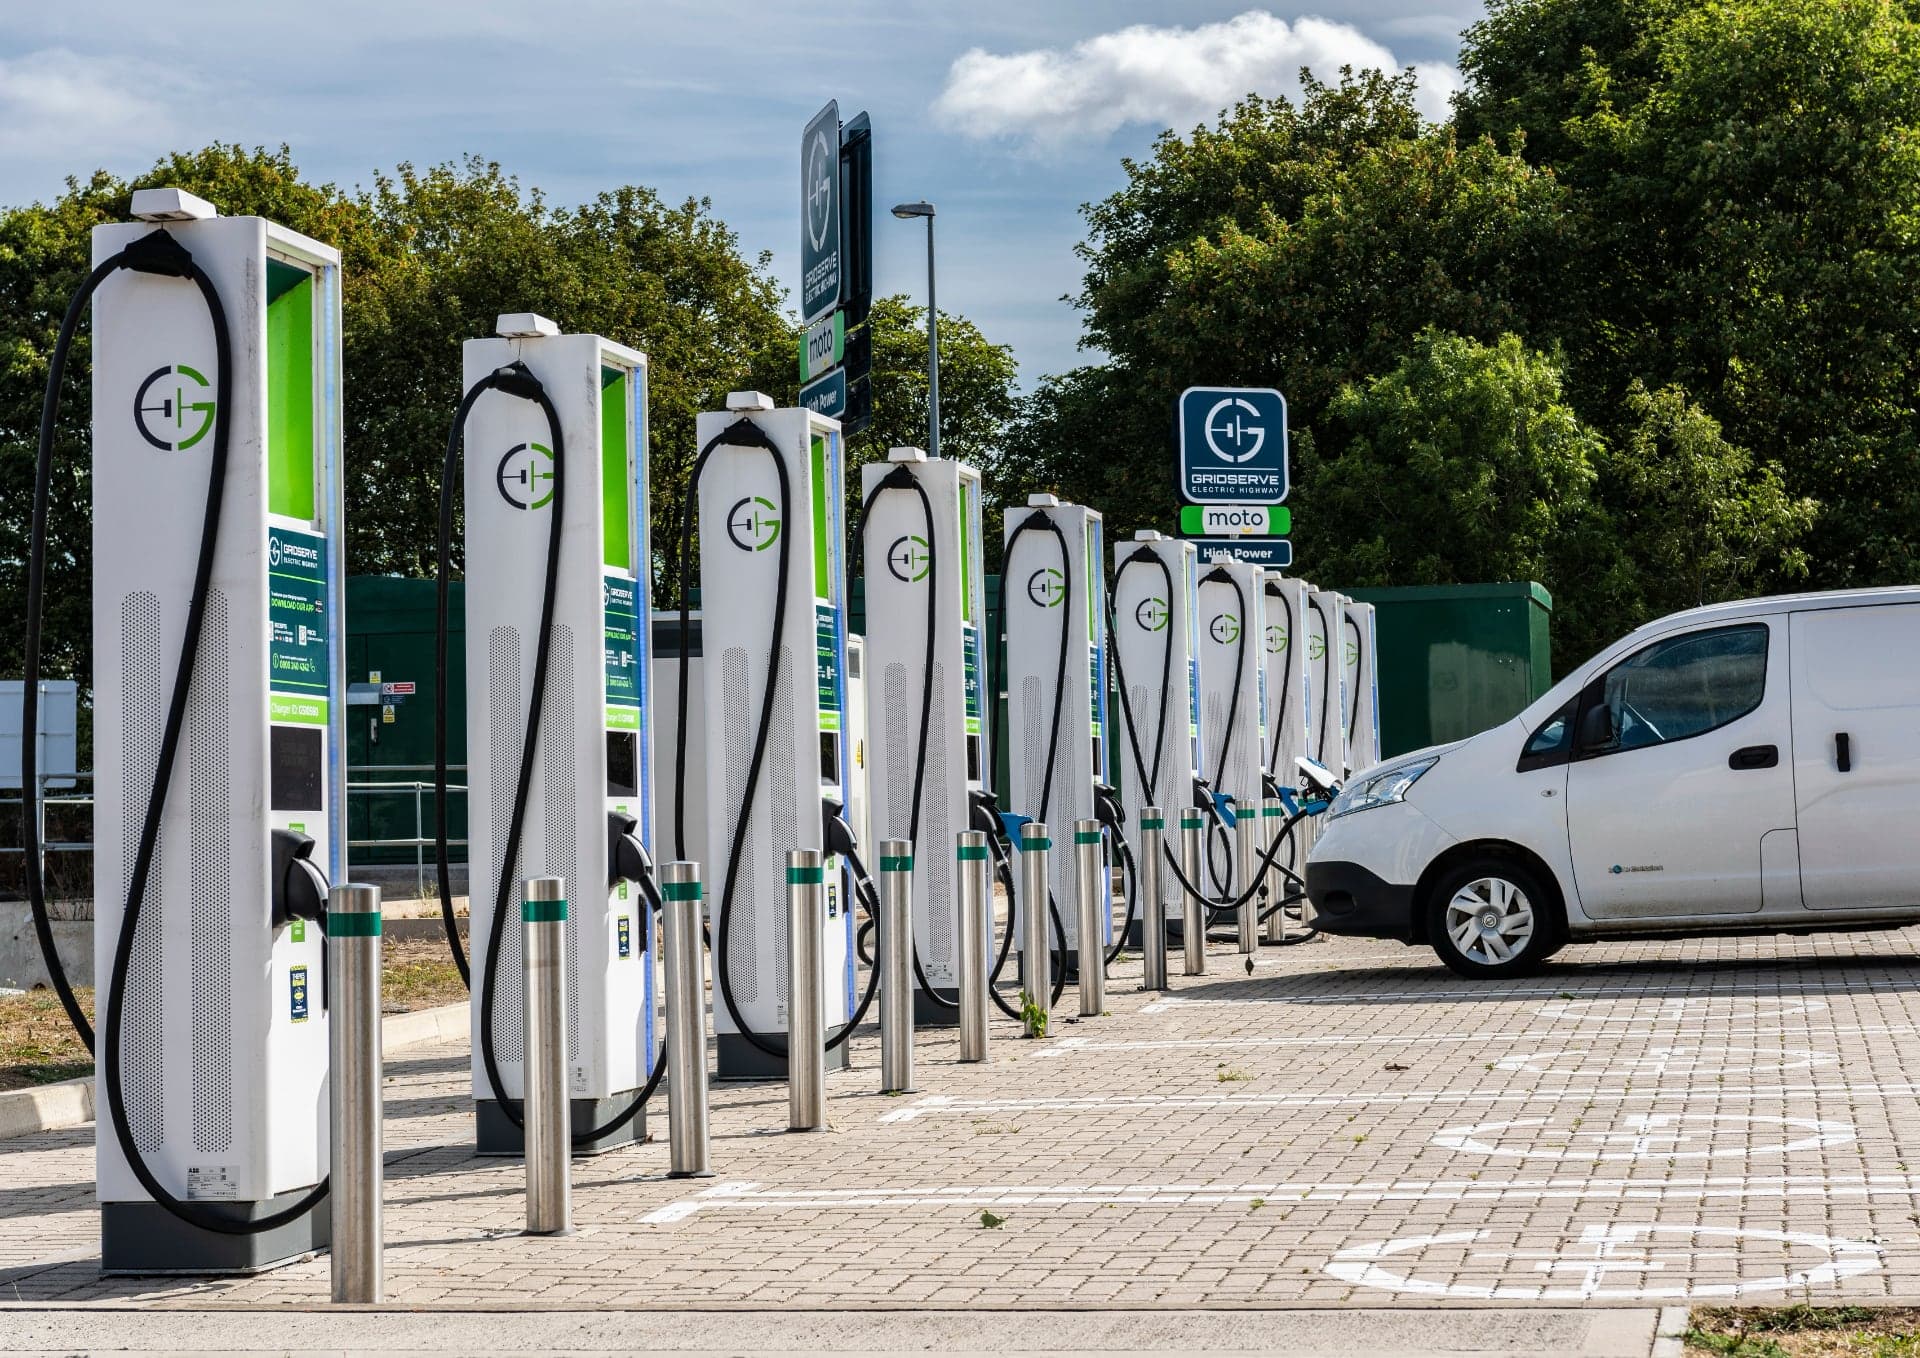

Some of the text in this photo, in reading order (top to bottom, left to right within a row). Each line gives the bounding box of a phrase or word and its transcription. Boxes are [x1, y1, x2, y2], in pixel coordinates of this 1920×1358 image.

[809, 326, 833, 362] moto
[819, 390, 837, 411] Power
[1191, 473, 1280, 485] GRIDSERVE
[1191, 486, 1280, 495] ELECTRIC HIGHWAY
[1208, 509, 1264, 526] moto
[283, 543, 318, 560] GRIDSERVE
[1234, 548, 1273, 559] Power
